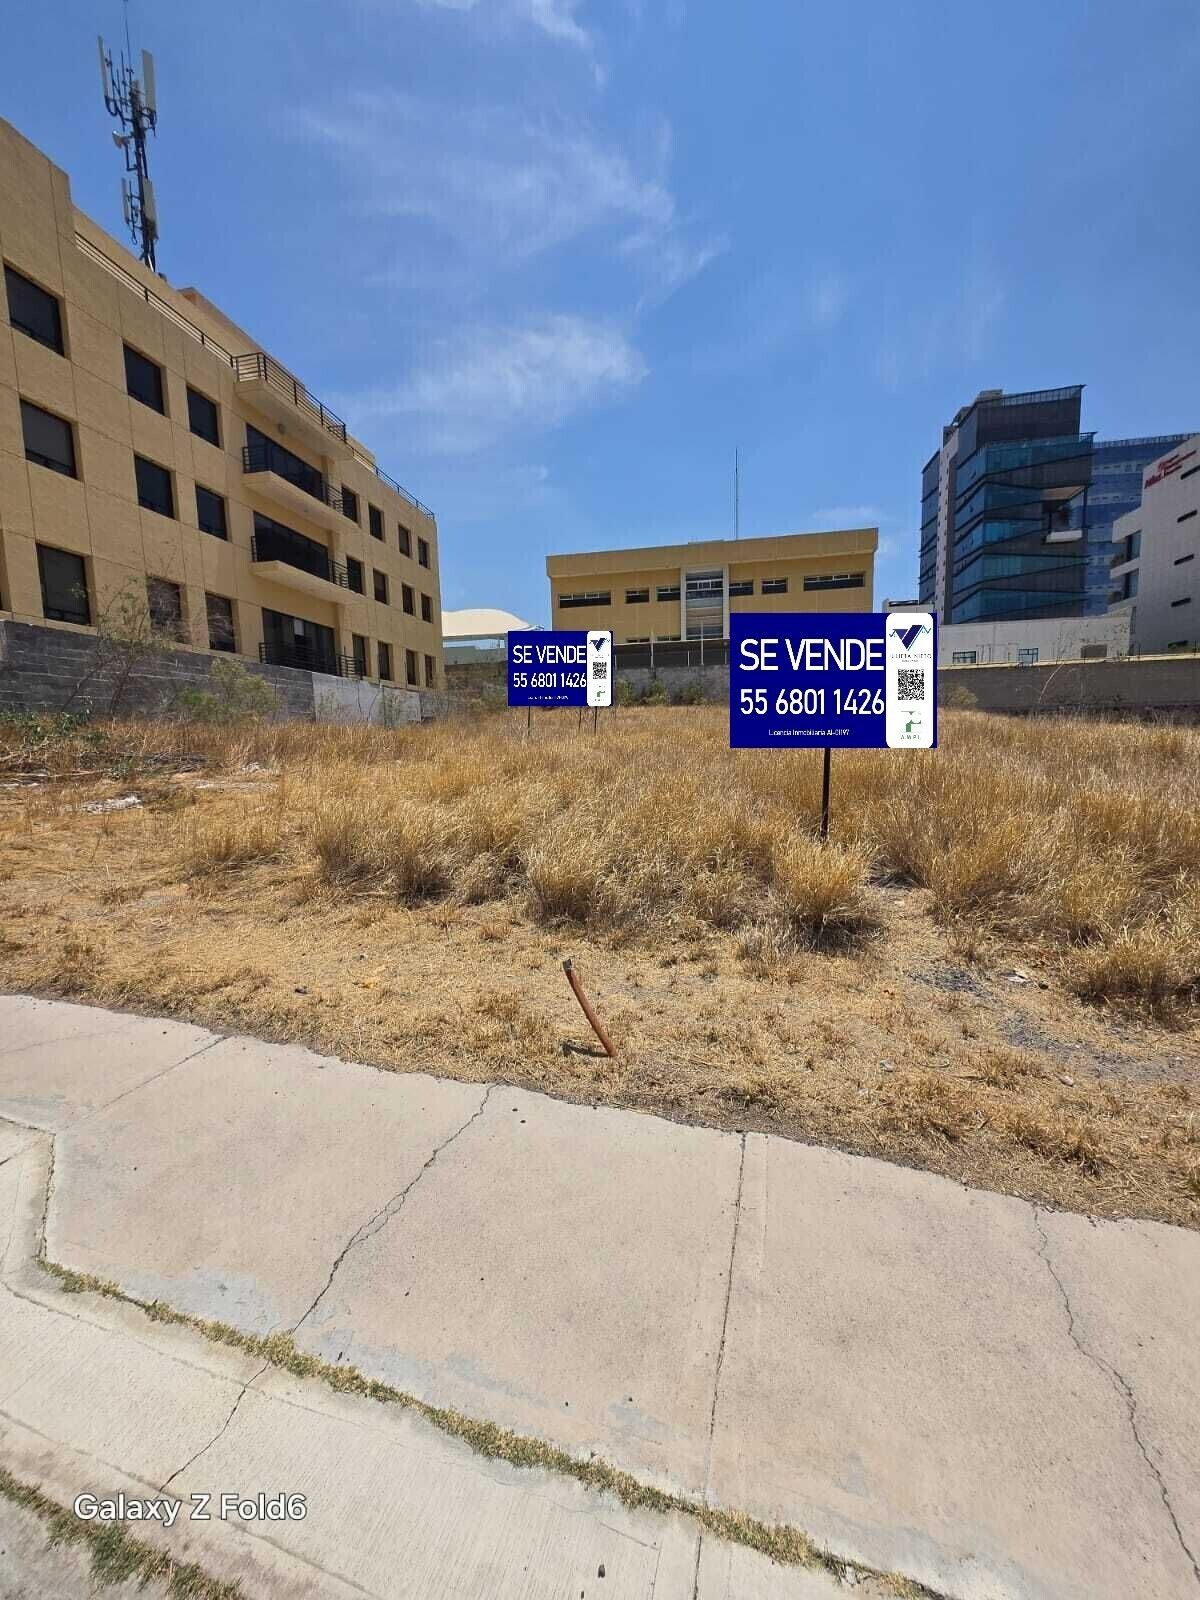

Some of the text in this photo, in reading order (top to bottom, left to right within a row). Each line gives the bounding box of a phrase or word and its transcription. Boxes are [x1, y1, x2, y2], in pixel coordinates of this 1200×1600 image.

[512, 645, 587, 664] SE VENDE
[739, 638, 885, 671] SE VENDE
[513, 672, 587, 688] 55 6801 1426
[740, 688, 885, 715] 55 6801 1426
